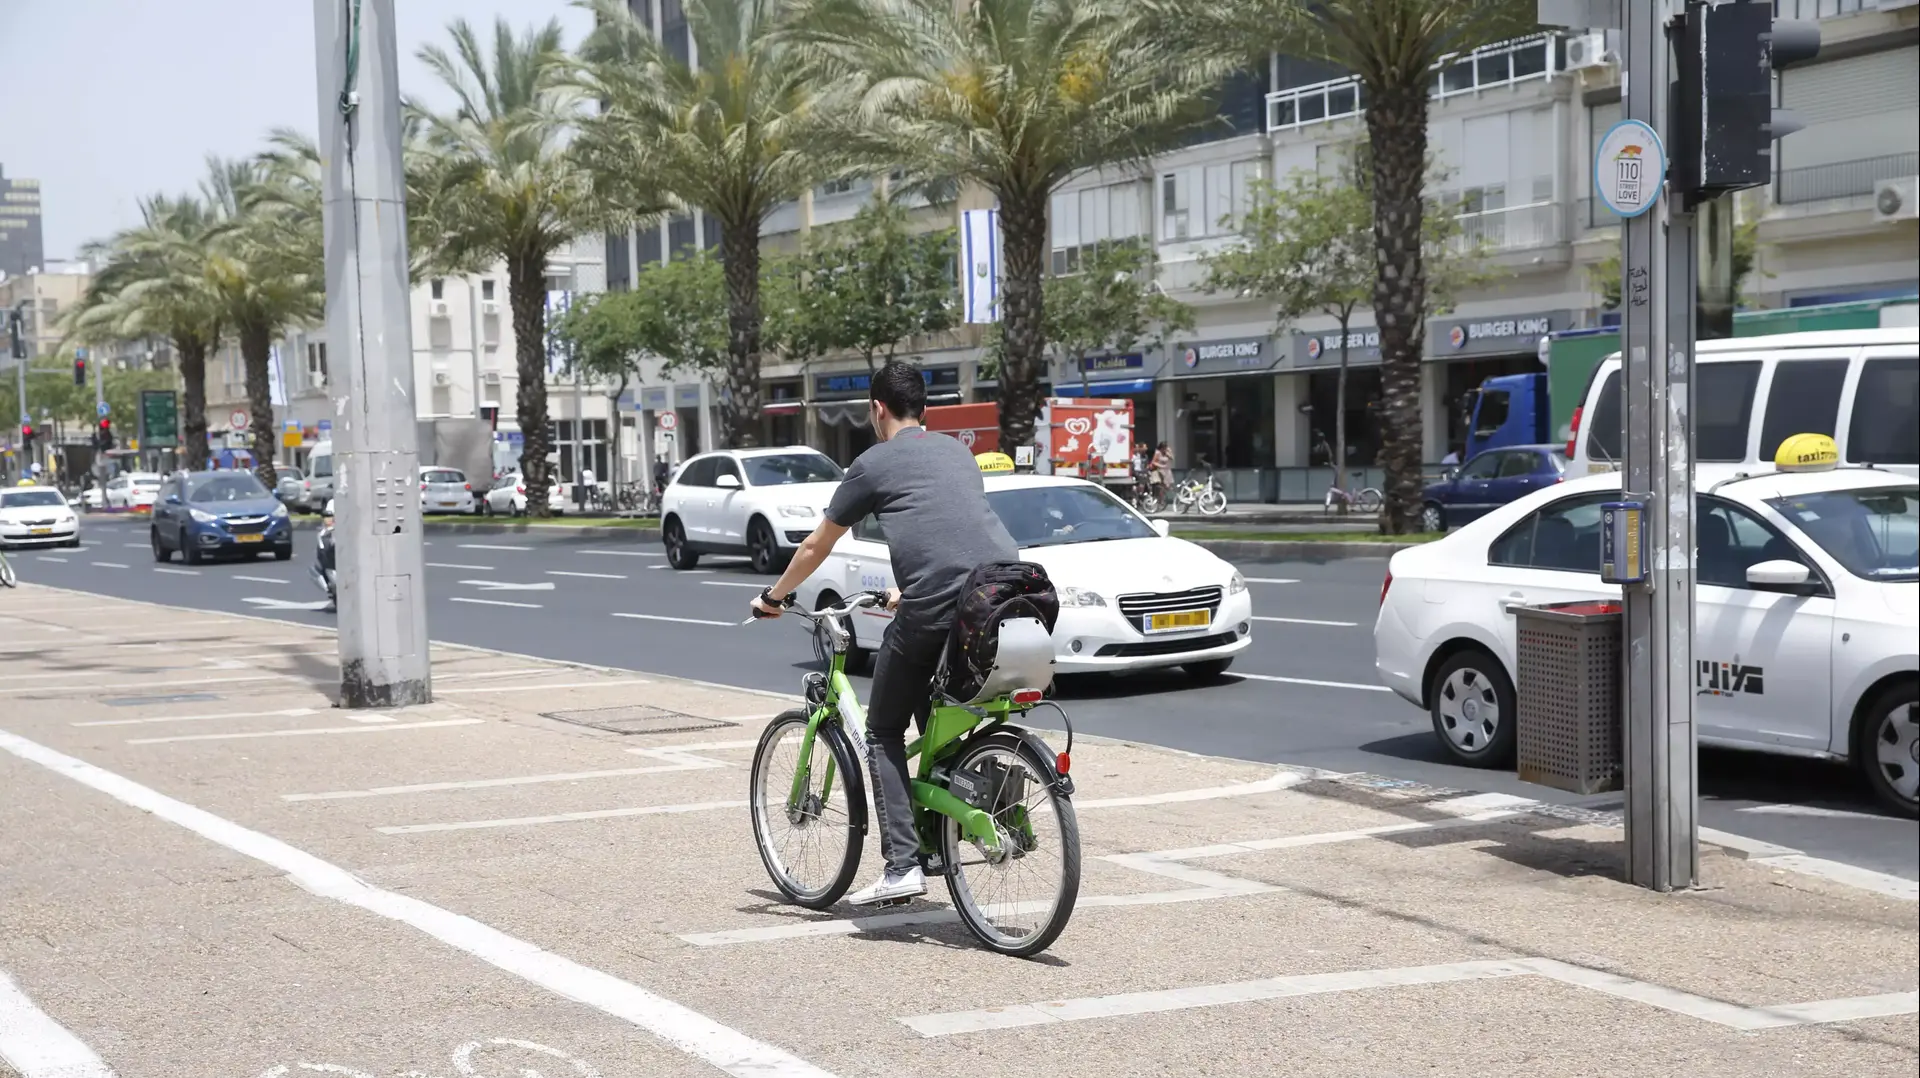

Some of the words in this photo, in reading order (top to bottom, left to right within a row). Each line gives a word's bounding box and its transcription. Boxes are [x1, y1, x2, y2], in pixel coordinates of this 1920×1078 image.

[1620, 162, 1638, 180] 110
[1618, 190, 1638, 200] LOVE
[1469, 321, 1516, 338] BURGER
[1516, 318, 1549, 335] KING
[1364, 331, 1380, 348] KI
[1199, 344, 1234, 360] BURGER
[1234, 341, 1259, 357] KING
[1797, 449, 1820, 463] taxi
